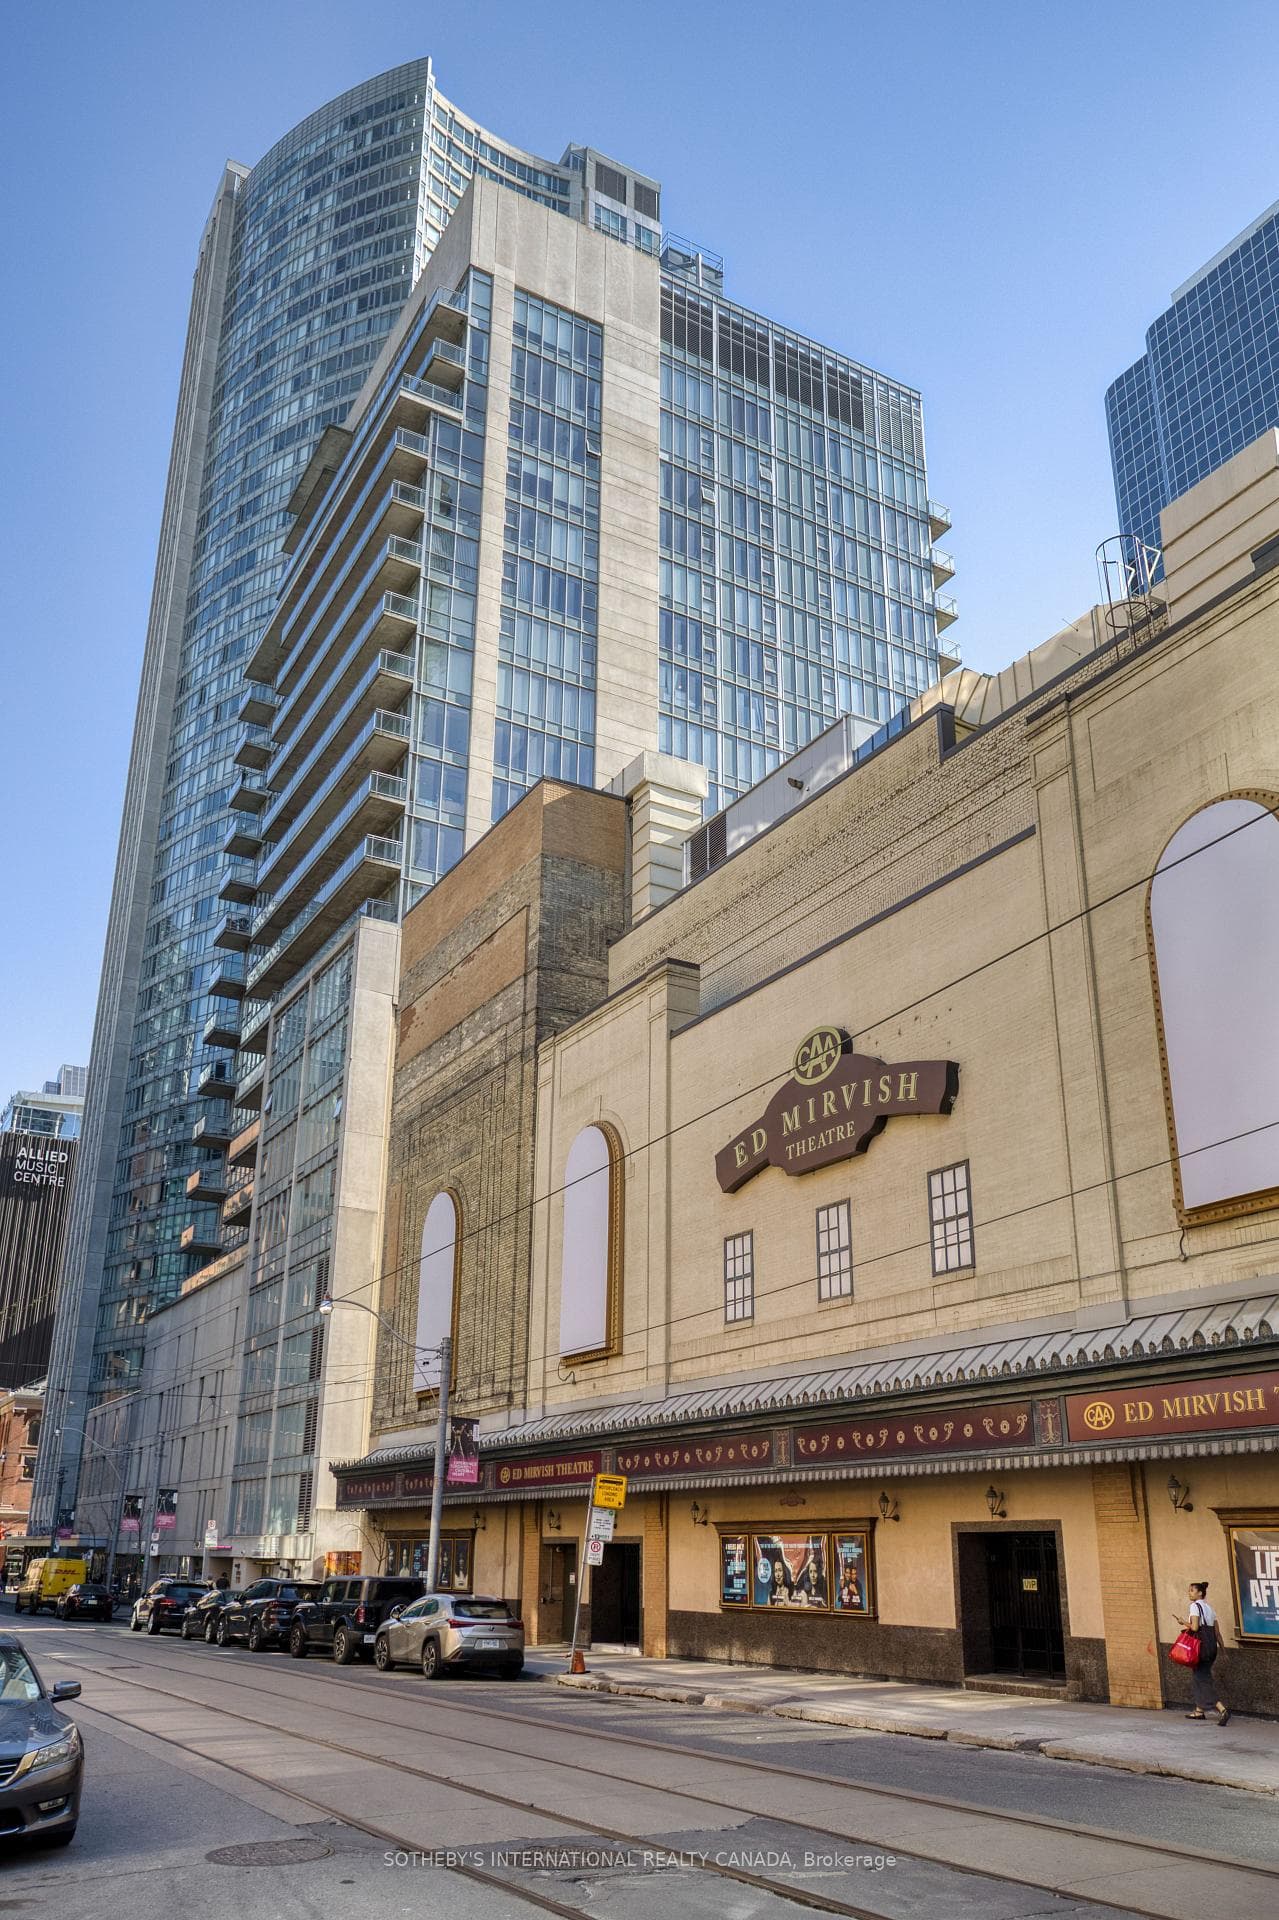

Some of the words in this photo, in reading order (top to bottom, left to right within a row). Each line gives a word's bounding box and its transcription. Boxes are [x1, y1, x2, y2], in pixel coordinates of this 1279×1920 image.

[797, 1034, 836, 1078] CAA
[733, 1128, 767, 1168] ED
[781, 1072, 918, 1136] MIRVISH
[786, 1120, 856, 1161] THEATRE
[17, 1147, 68, 1163] ALLIED
[15, 1159, 57, 1174] MUSIC
[14, 1171, 66, 1187] CENTRE
[1086, 1405, 1112, 1426] CAA
[1123, 1401, 1154, 1423] ED
[1162, 1388, 1267, 1419] MIRVISH
[512, 1468, 523, 1480] ED
[524, 1464, 554, 1479] MIRVISH
[555, 1460, 594, 1475] THEATRE
[1024, 1580, 1036, 1589] VIP
